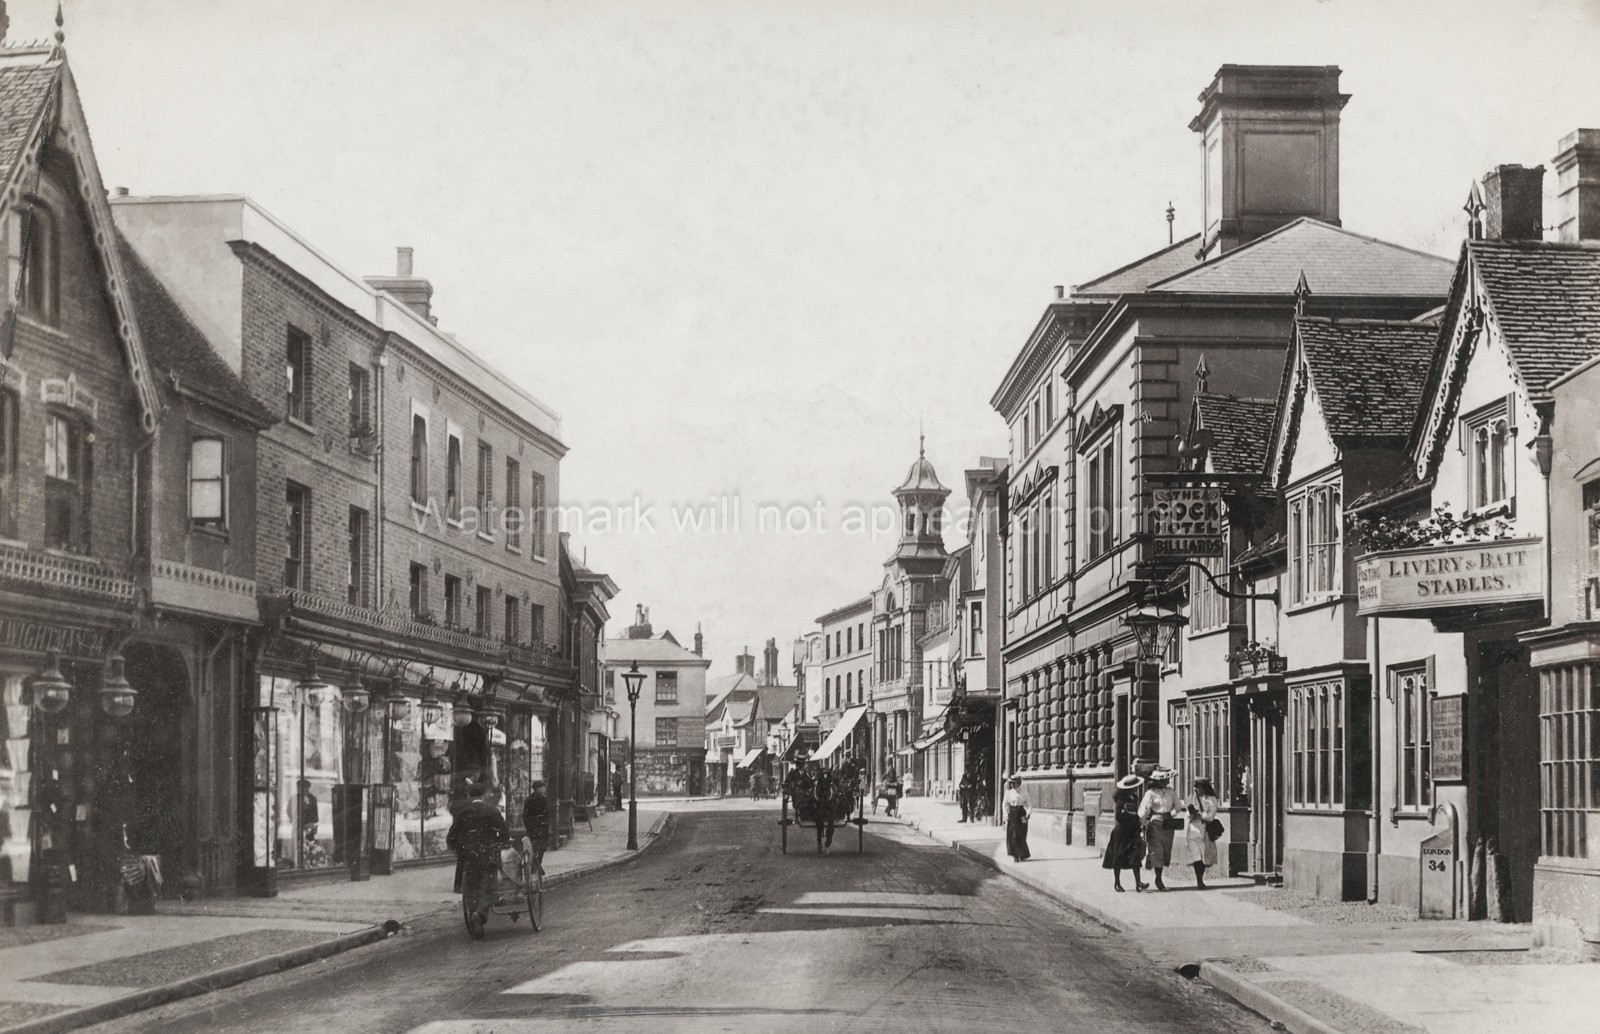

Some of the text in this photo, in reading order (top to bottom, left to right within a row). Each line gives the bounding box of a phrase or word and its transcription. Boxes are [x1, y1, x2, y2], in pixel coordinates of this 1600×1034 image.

[1172, 490, 1200, 500] THE
[1154, 502, 1219, 521] COCK
[1155, 522, 1218, 534] HOTEL
[1155, 540, 1221, 554] BILLIARDS
[1388, 550, 1527, 577] LIVERY & BAIT
[1423, 848, 1452, 856] LONDON
[1428, 859, 1446, 872] 34
